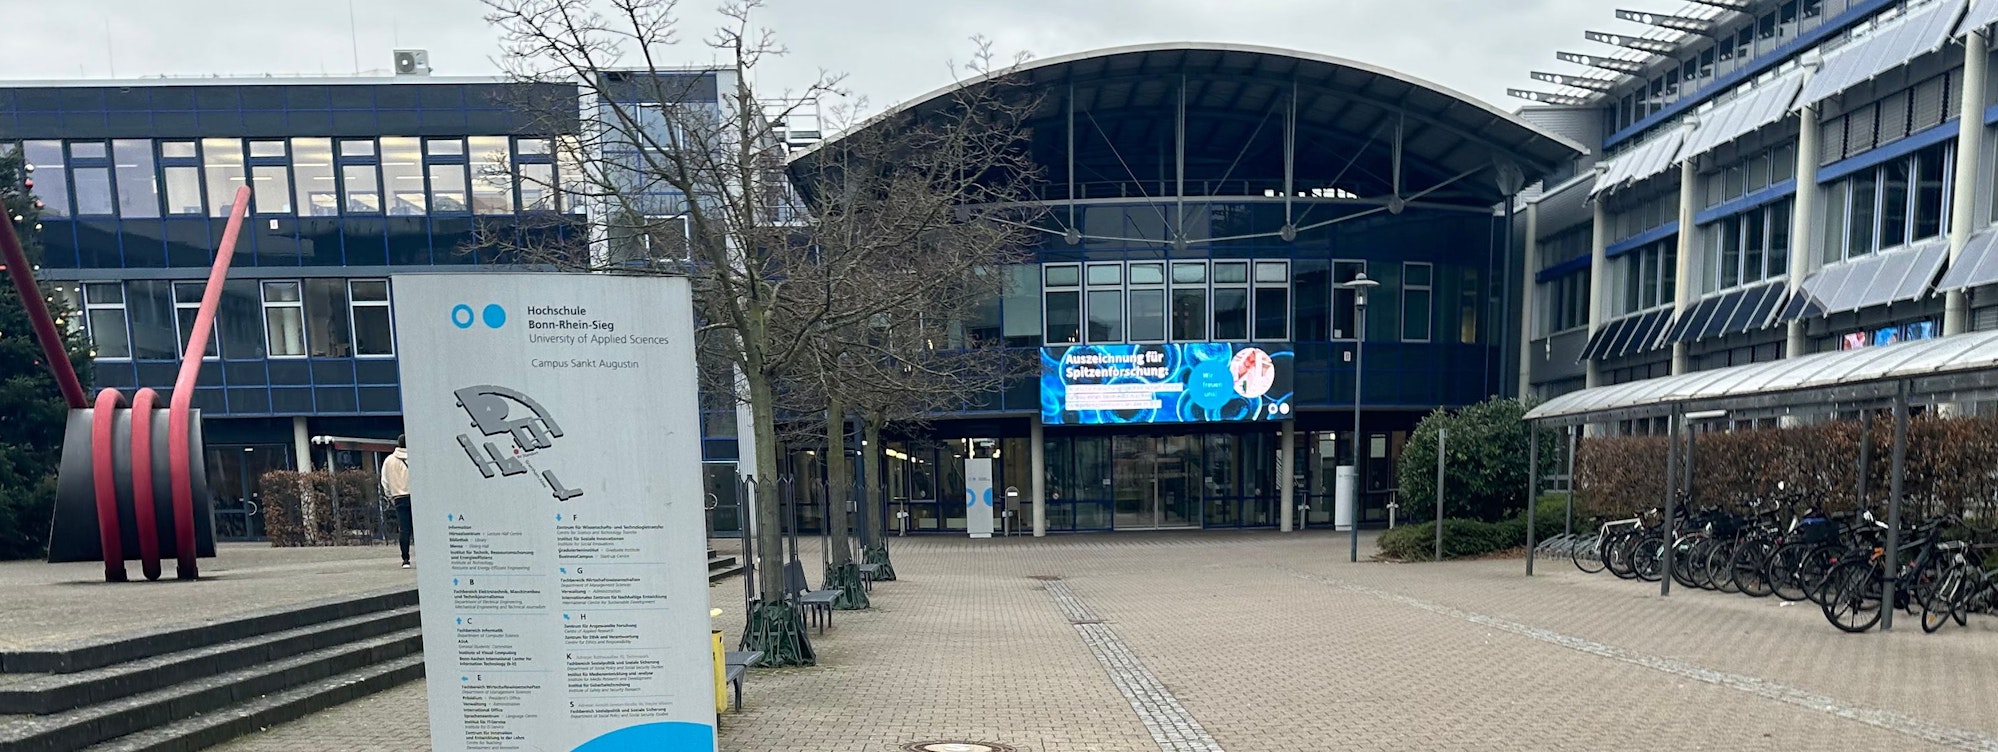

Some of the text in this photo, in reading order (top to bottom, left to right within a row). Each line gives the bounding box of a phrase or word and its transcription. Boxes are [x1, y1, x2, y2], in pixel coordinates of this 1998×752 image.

[527, 305, 586, 315] Hochschule
[528, 320, 614, 332] Bonn-Rhein-Sieg
[529, 333, 669, 346] University of Applied Sciences
[531, 358, 639, 370] Campus Sankt Augustin
[1065, 351, 1164, 365] Auszeichnung für
[1065, 366, 1169, 379] Spitzenforschung:
